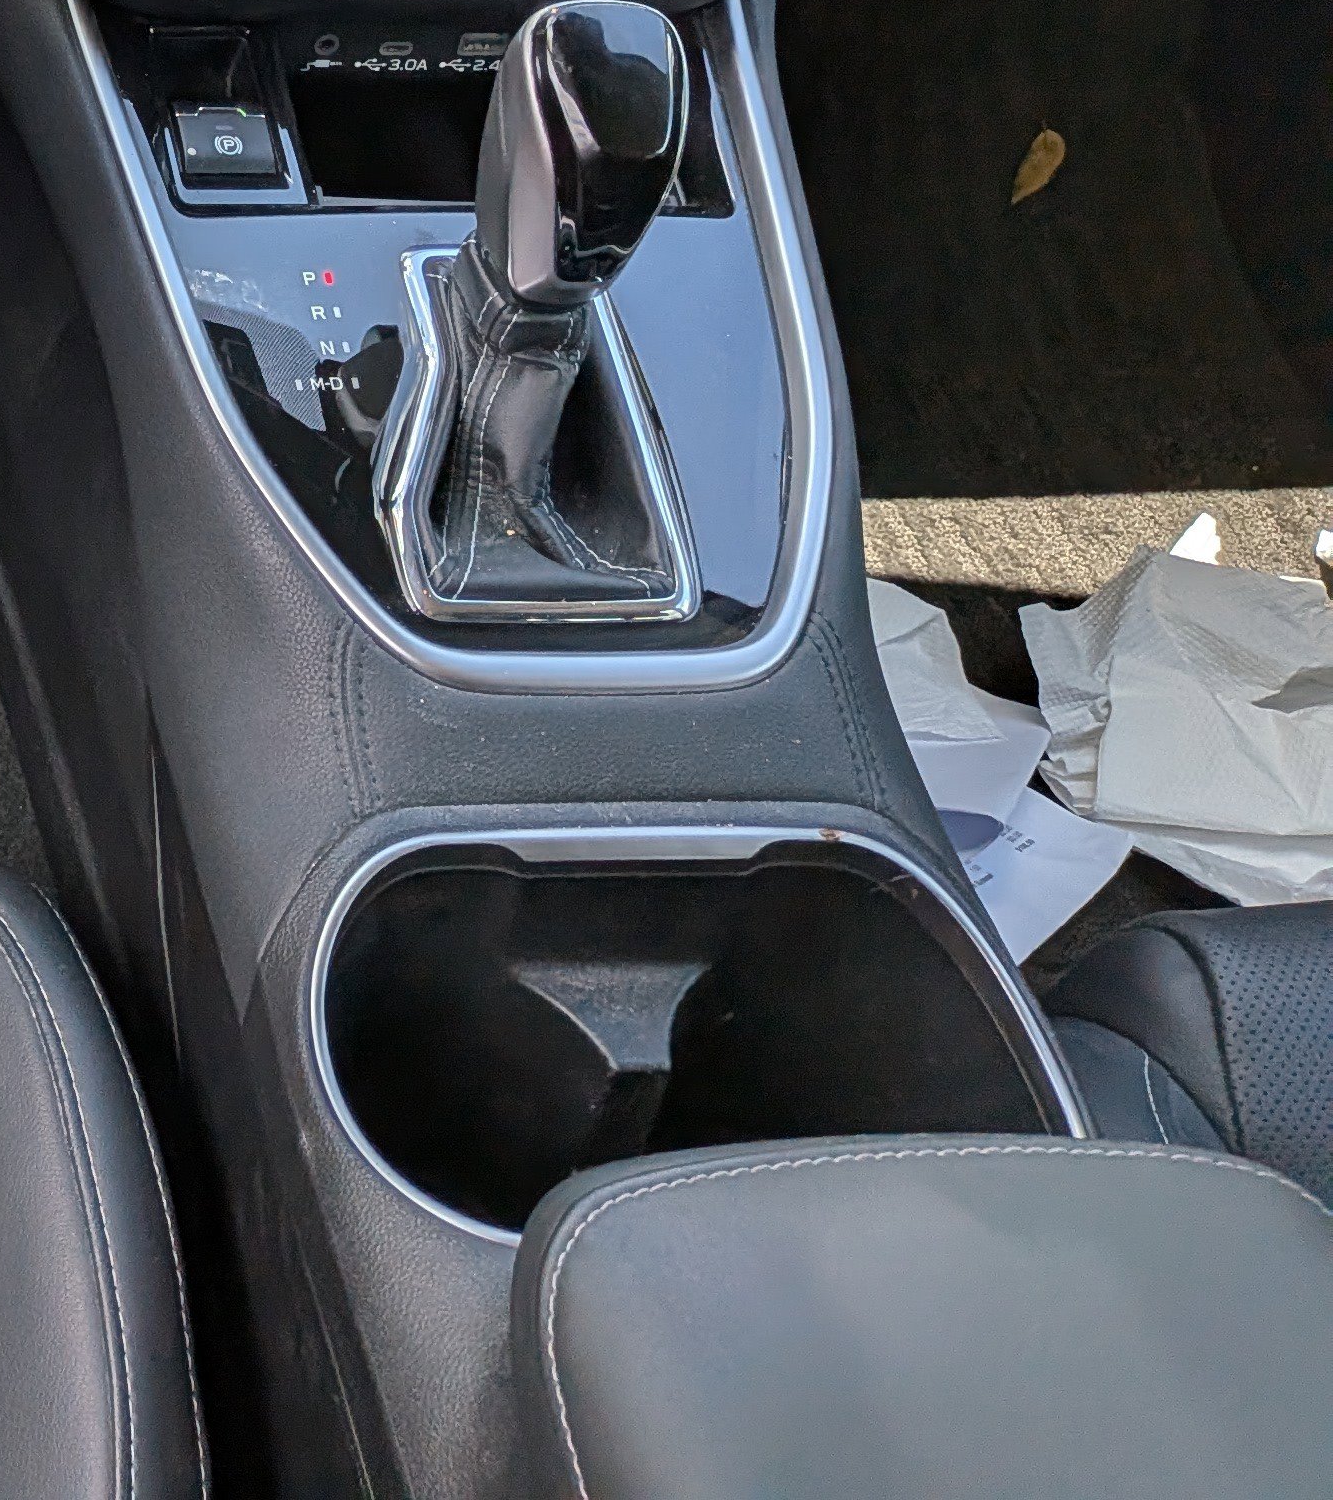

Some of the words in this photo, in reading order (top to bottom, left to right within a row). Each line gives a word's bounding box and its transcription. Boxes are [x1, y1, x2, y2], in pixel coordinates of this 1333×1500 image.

[387, 58, 428, 72] 3.0A
[302, 271, 317, 286] P
[312, 305, 326, 320] R
[320, 341, 335, 355] N
[310, 376, 345, 391] M-D
